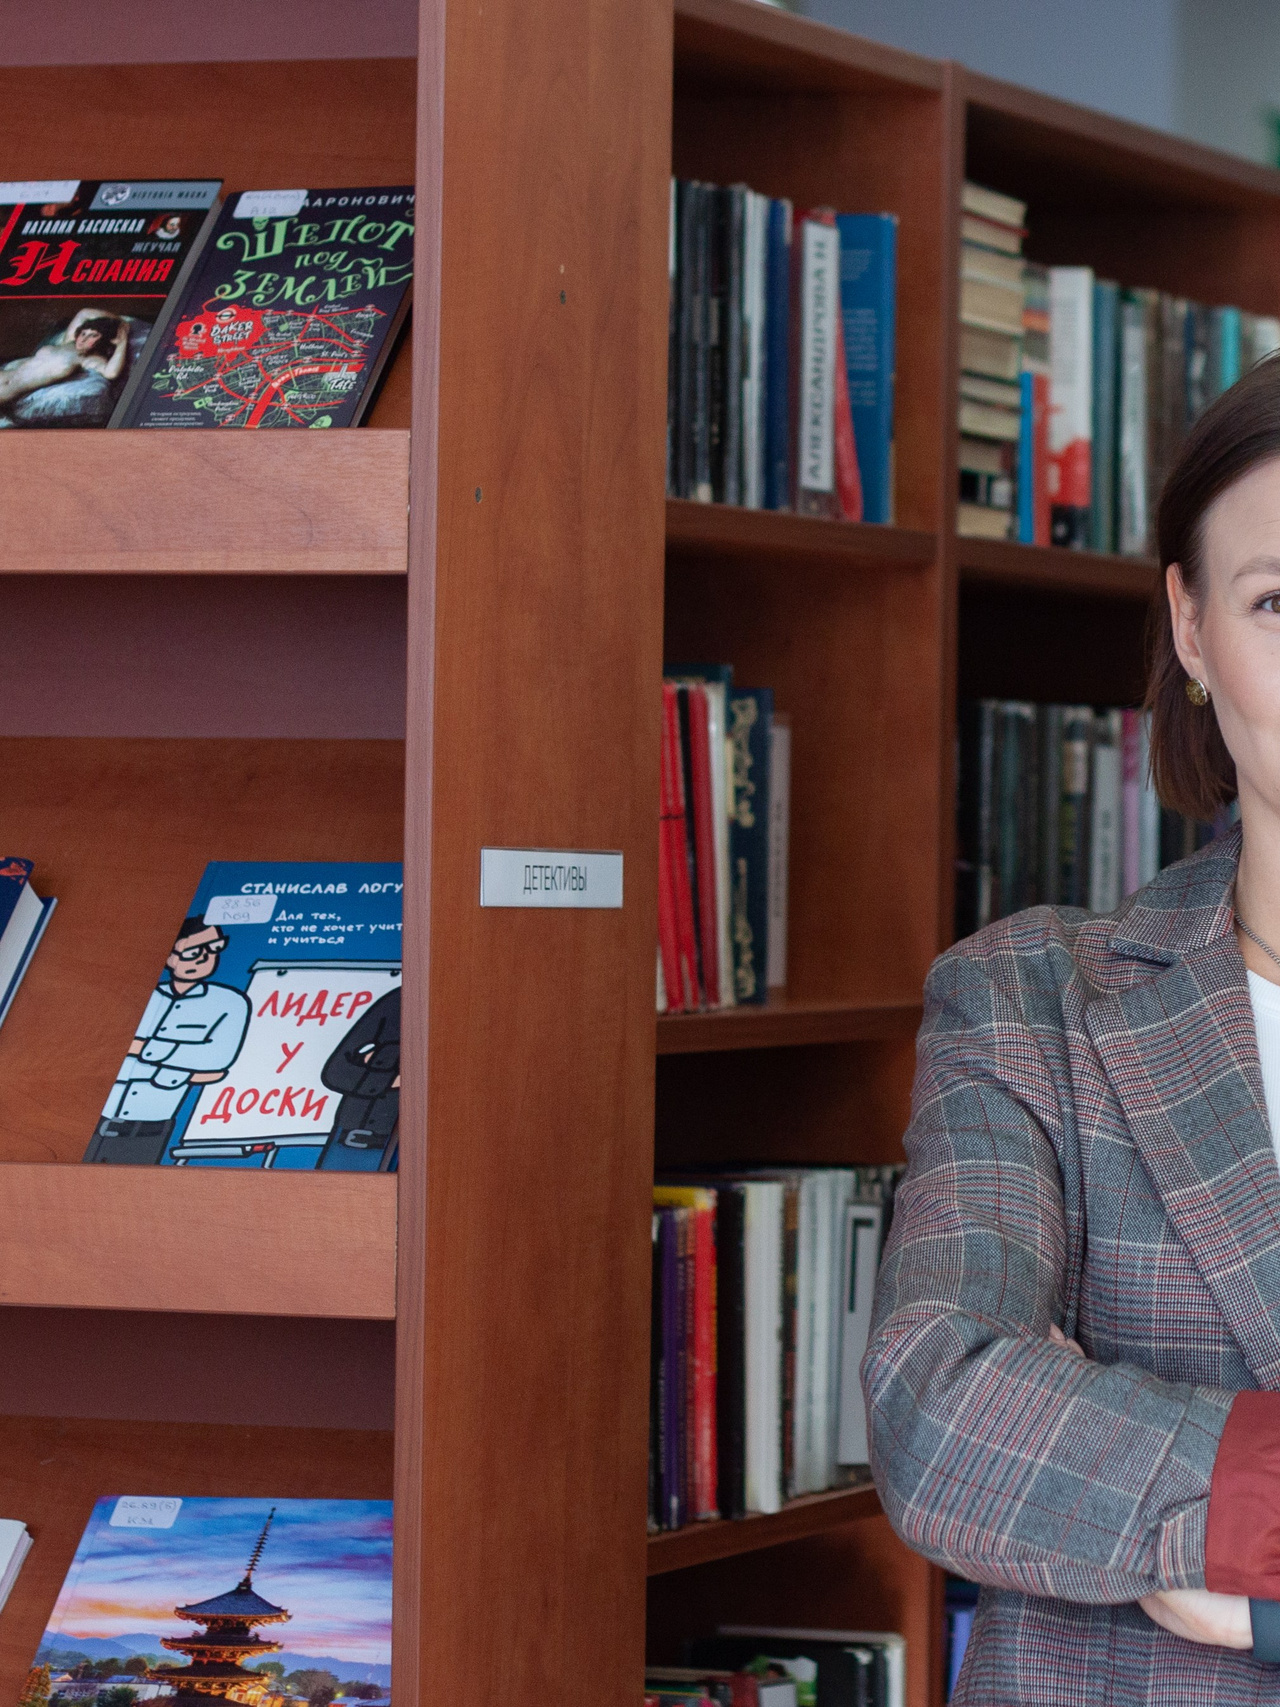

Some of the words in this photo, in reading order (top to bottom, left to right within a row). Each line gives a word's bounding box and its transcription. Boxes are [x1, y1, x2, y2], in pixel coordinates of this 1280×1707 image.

[21, 219, 76, 236] НАТАЛИЯ
[77, 218, 146, 235] БАСОВСКАЯ
[216, 214, 414, 262] ШЕПОТ
[132, 241, 181, 253] ЖГУЧАЯ
[215, 258, 413, 306] ЗЕМЛЕЙ
[210, 321, 253, 337] BAKER
[213, 331, 250, 345] STREET
[523, 864, 587, 895] ДЕТЕКТИВЫ
[240, 882, 348, 895] СТАНИСЛАВ
[358, 882, 403, 894] ЛОГУ
[275, 909, 303, 922] Для
[310, 912, 342, 922] тех,
[271, 925, 295, 933] кто
[301, 924, 317, 933] не
[323, 924, 364, 933] хочет
[268, 937, 277, 945] и
[283, 936, 345, 946] учиться
[257, 989, 373, 1027] ЛИДЕР
[276, 1041, 304, 1074] У
[200, 1086, 329, 1125] ДОСКИ
